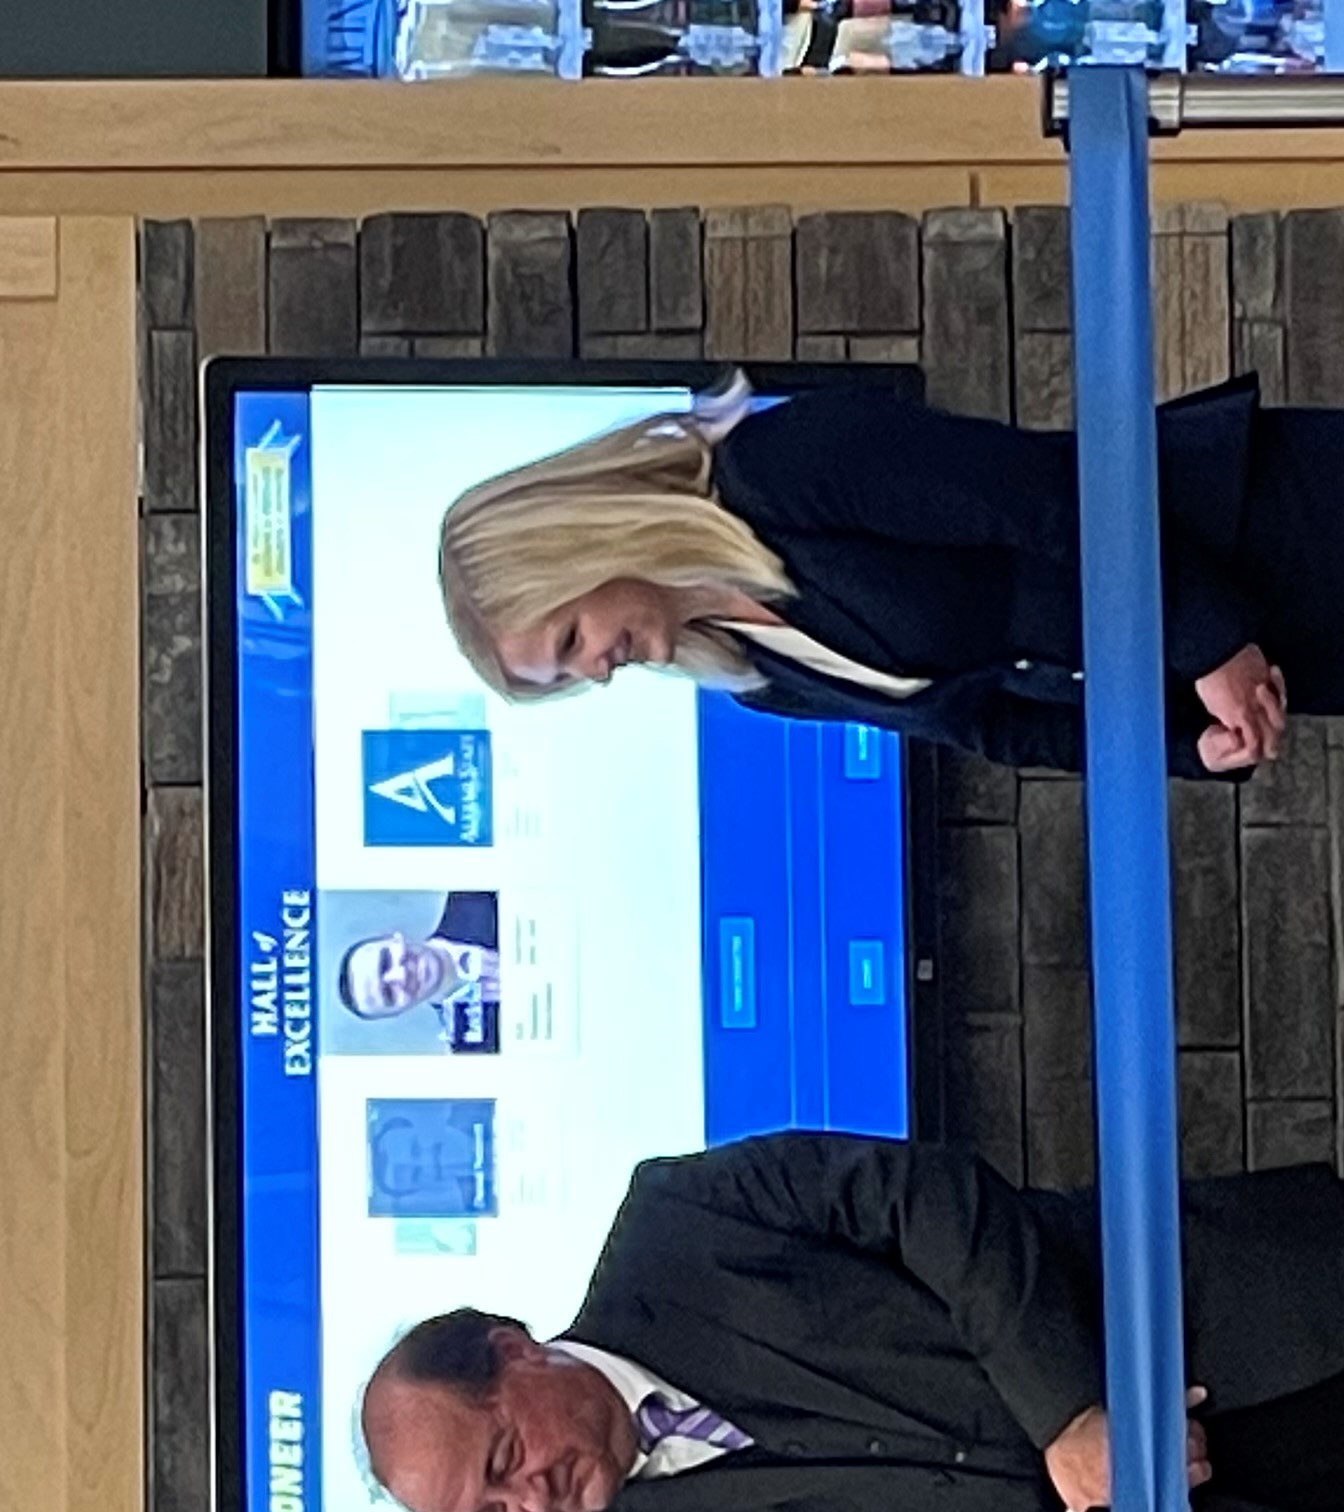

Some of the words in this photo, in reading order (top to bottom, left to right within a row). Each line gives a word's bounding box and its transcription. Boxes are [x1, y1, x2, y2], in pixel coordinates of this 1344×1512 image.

[252, 931, 278, 952] of
[250, 957, 278, 1036] HALL
[282, 890, 311, 1076] EXCELLENCE
